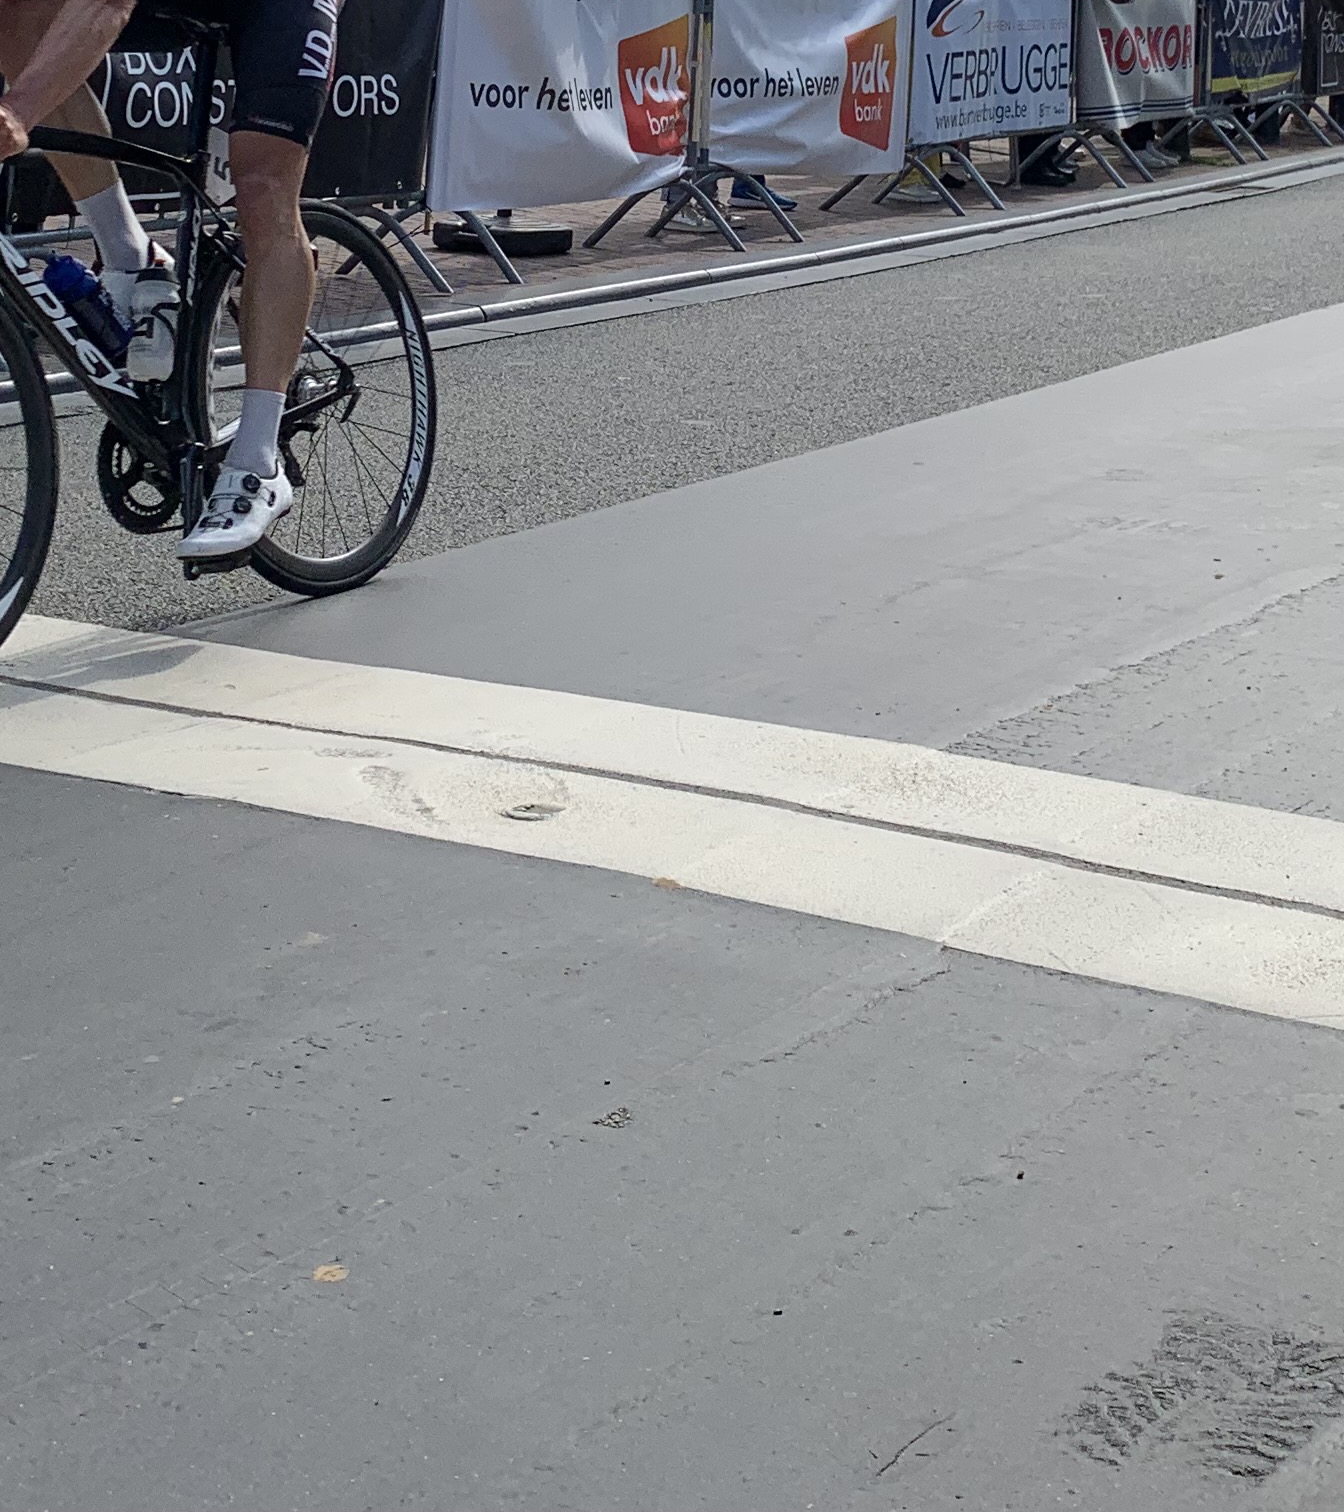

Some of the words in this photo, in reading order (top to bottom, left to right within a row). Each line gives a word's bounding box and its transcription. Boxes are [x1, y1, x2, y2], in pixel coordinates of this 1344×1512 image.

[470, 82, 529, 109] voor
[536, 76, 574, 112] het
[574, 78, 613, 111] leven
[625, 46, 687, 106] vdk
[763, 68, 794, 98] het
[796, 68, 840, 97] leven
[852, 44, 891, 95] vdk
[926, 42, 1068, 105] VERBRUGGE
[855, 99, 883, 122] bank
[405, 328, 428, 464] NIGHTHAWK
